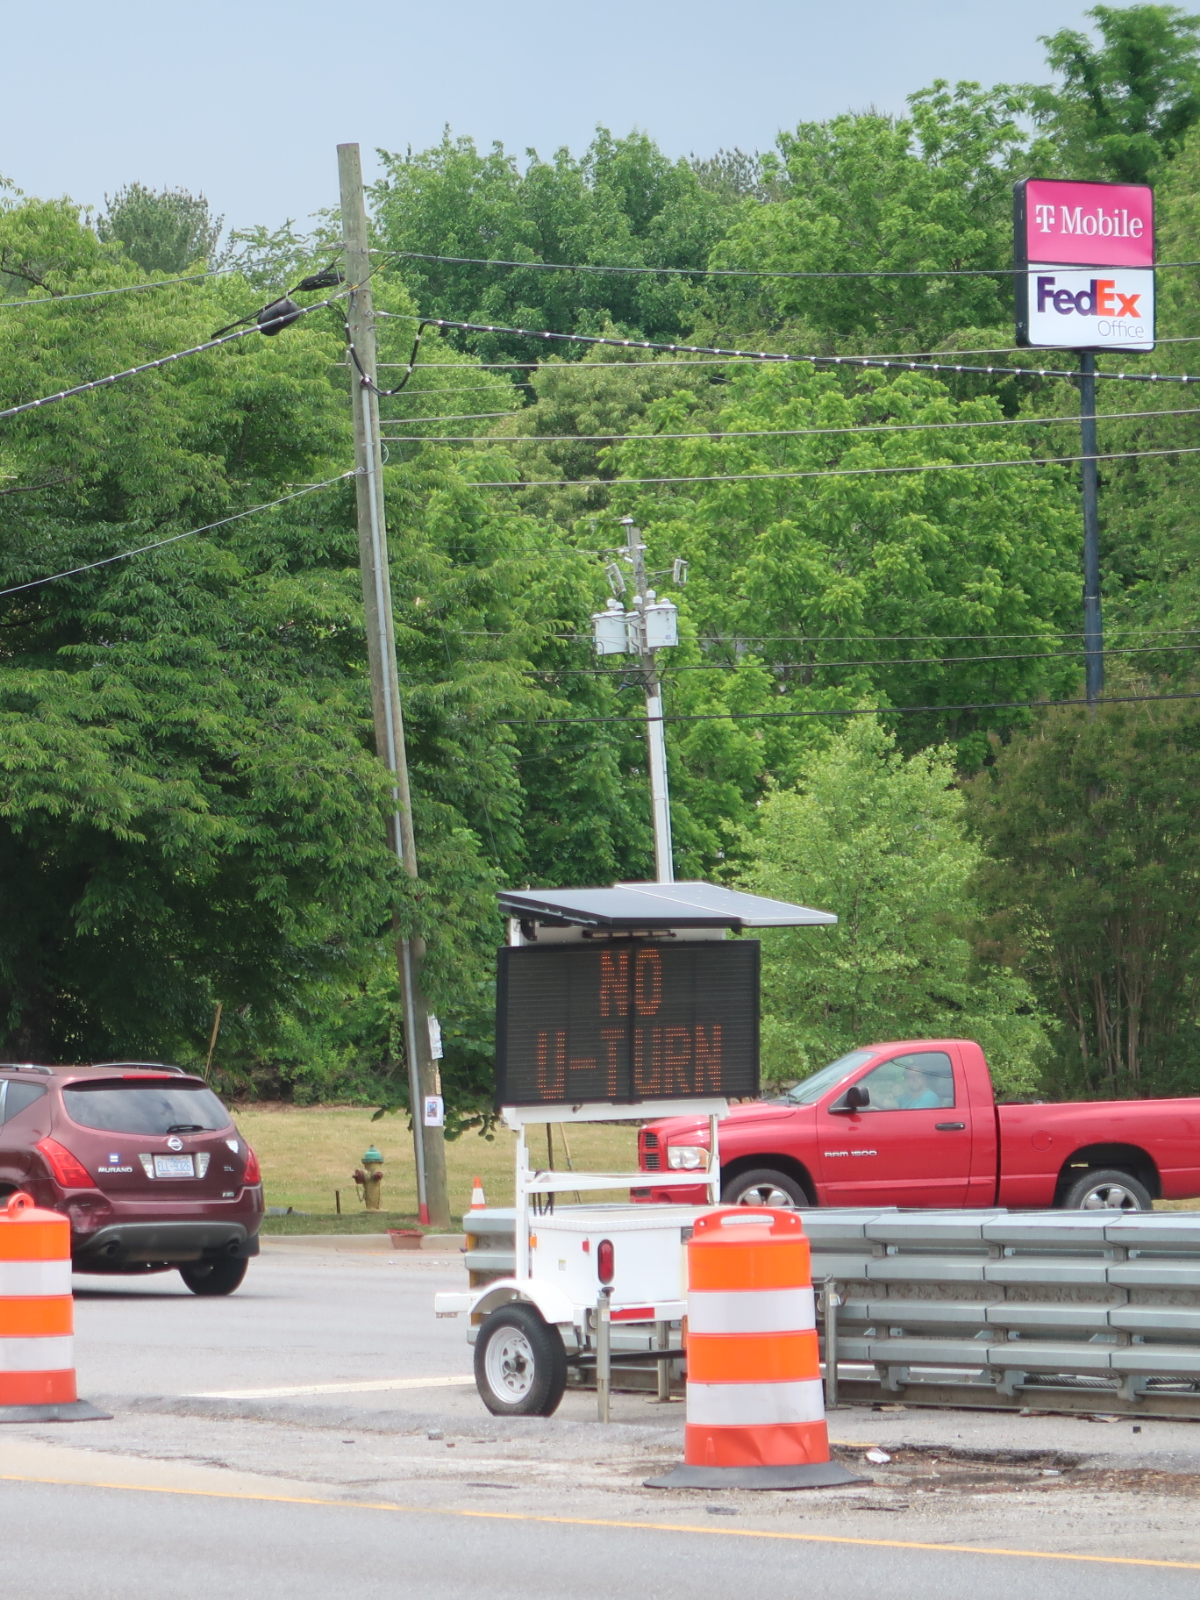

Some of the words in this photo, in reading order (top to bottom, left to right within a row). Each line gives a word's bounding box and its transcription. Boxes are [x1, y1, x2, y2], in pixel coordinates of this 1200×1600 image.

[1060, 205, 1143, 238] Mobile
[1037, 276, 1142, 318] FedEx
[1097, 319, 1145, 339] Office
[601, 949, 663, 1017] NO
[536, 1025, 722, 1099] U-TURN
